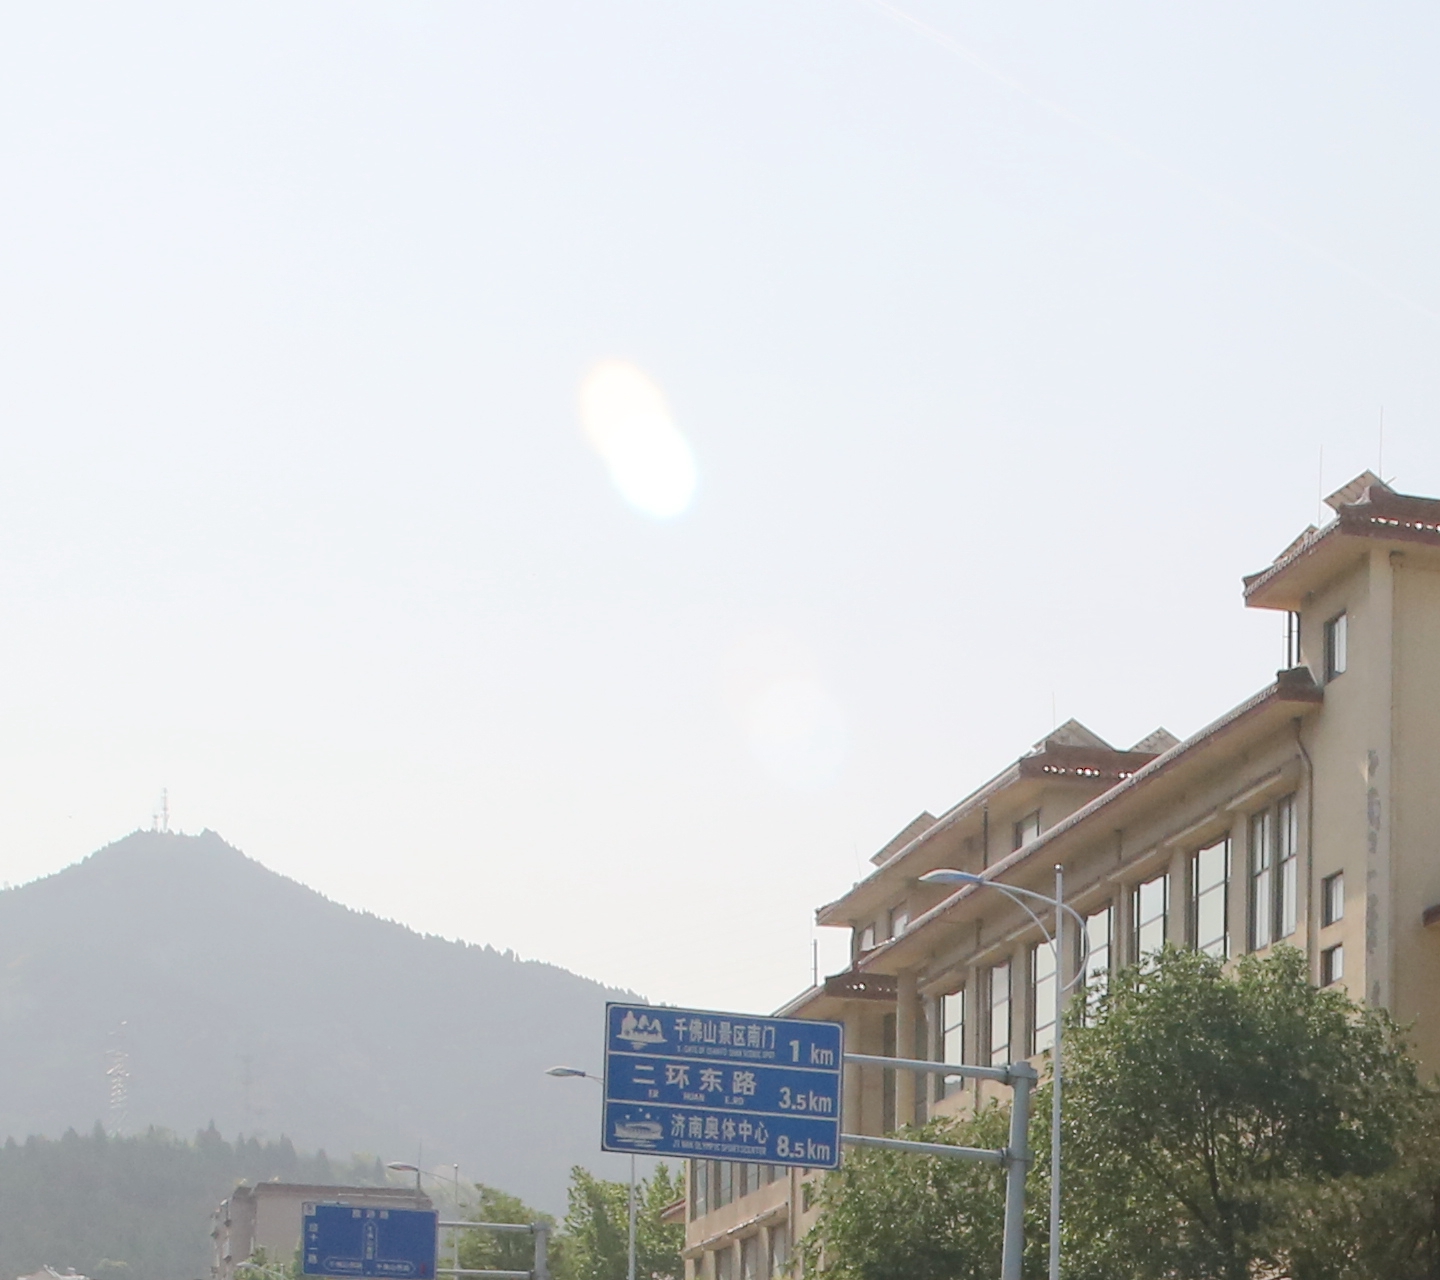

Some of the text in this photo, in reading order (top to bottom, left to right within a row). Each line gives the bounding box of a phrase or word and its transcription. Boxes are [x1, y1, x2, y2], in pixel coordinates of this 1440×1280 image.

[674, 1018, 775, 1049] 千佛山景区南门
[789, 1040, 800, 1062] 1
[810, 1043, 833, 1065] km
[632, 1064, 757, 1096] 二环东路
[671, 1113, 769, 1144] 济南奥体中心
